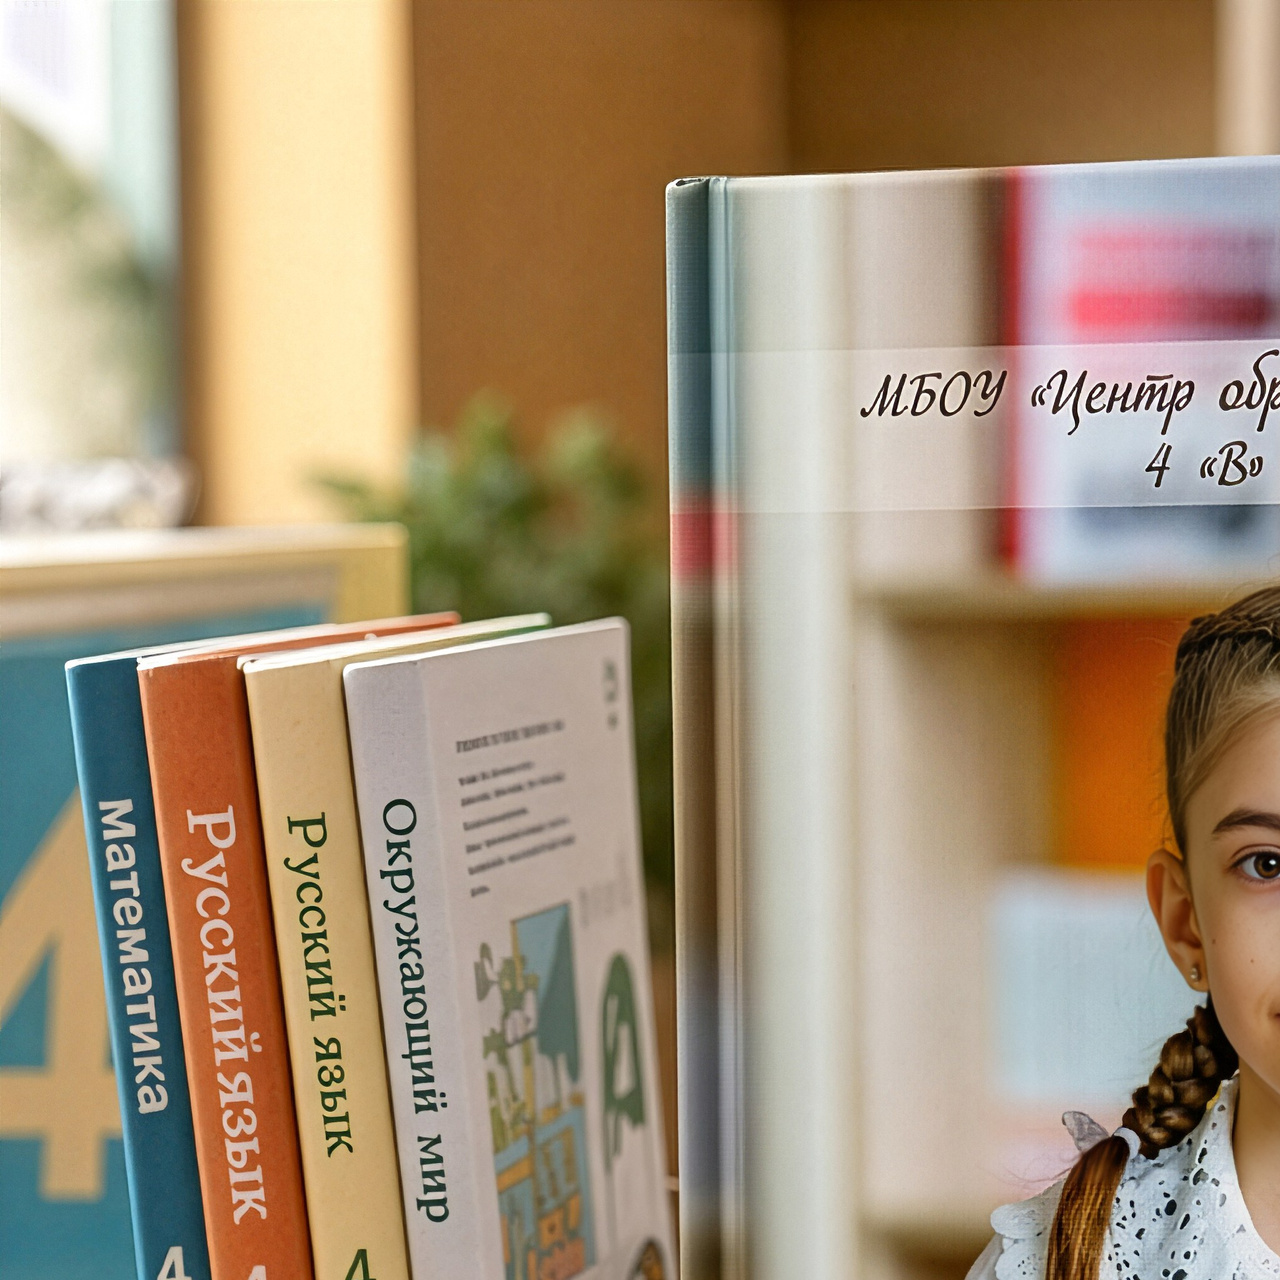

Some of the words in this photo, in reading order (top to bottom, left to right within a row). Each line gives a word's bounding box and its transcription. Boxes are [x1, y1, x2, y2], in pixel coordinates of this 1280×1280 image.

[860, 370, 1007, 418] МБОУ
[1031, 369, 1195, 436] «Центр
[1145, 442, 1172, 487] 4
[1200, 440, 1263, 487] «В»
[98, 798, 169, 1115] Математика
[181, 804, 263, 1066] Русский
[283, 811, 348, 1021] Русский
[312, 1036, 354, 1157] язык
[379, 798, 446, 1115] Окружающий
[416, 1134, 451, 1224] мир
[215, 1069, 268, 1226] язык
